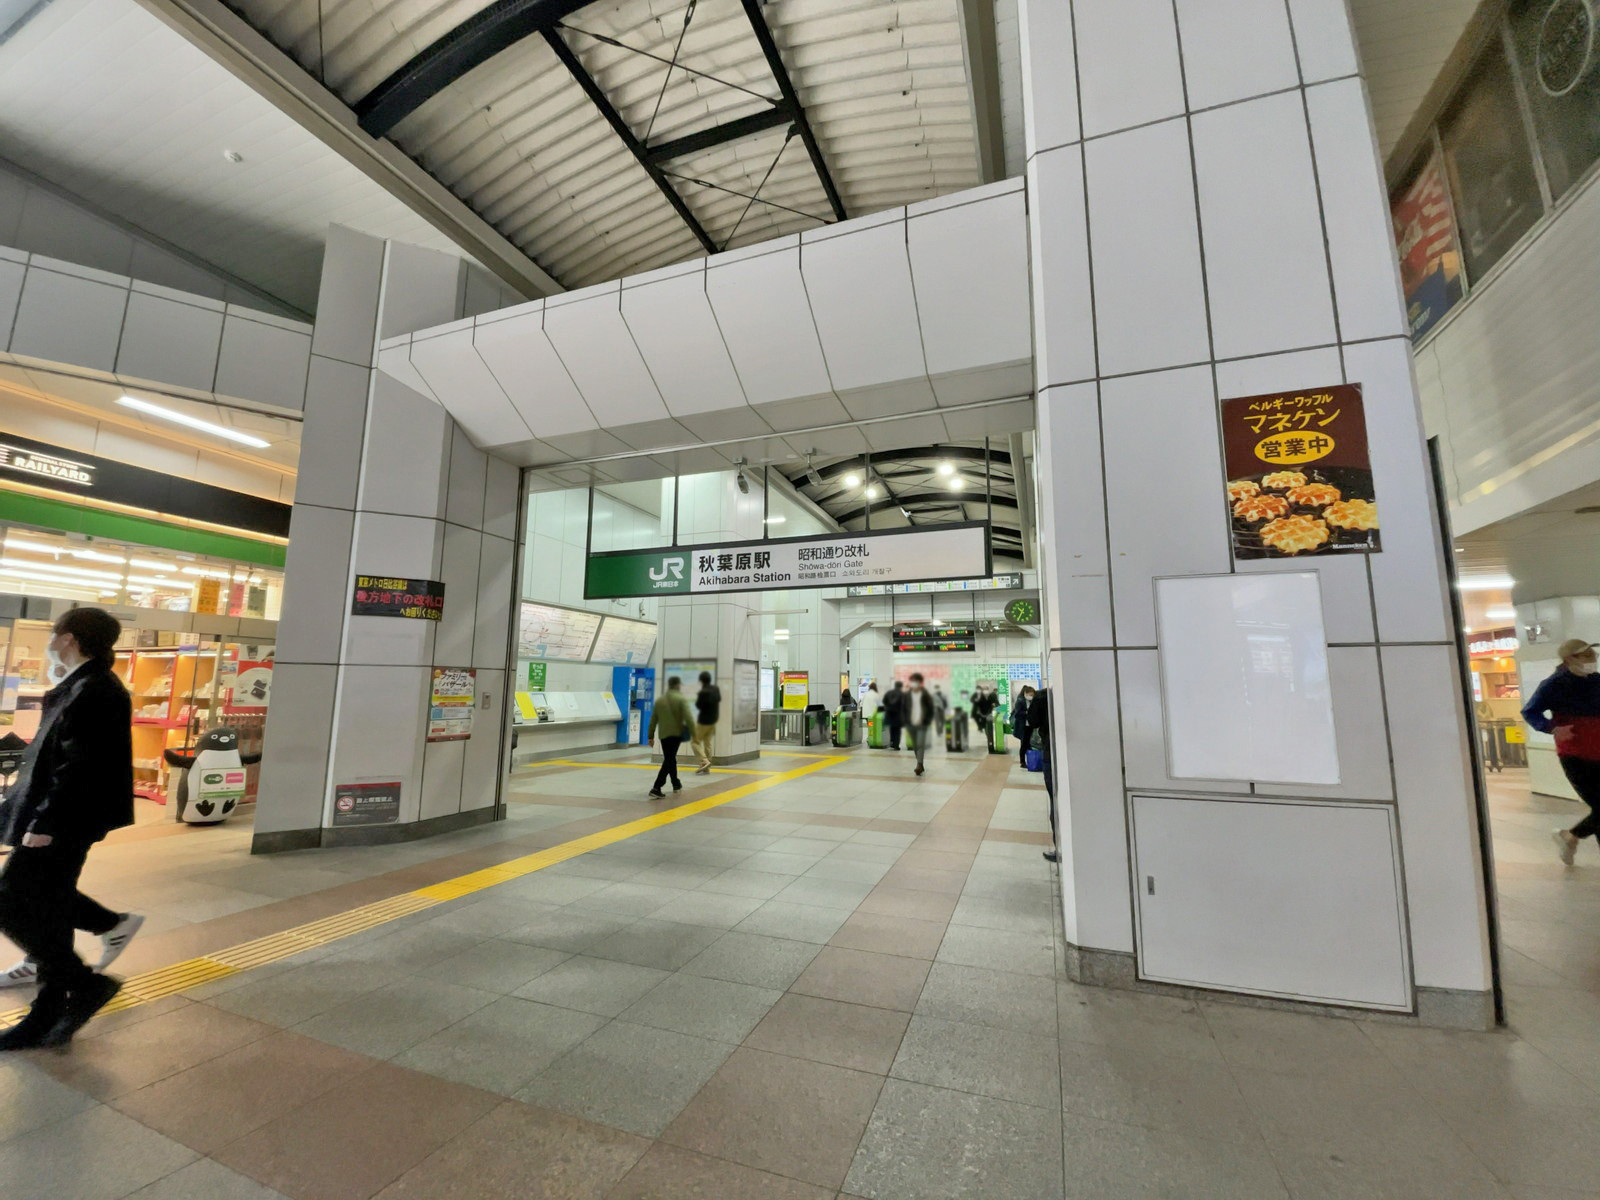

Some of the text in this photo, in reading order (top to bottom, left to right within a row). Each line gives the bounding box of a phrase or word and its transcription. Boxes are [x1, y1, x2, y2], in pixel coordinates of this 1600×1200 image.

[1249, 394, 1333, 411] ベルギーワッフル
[1243, 408, 1340, 434] マネケン
[1261, 435, 1328, 459] 営業中
[15, 456, 90, 482] RAILYARD
[699, 551, 771, 573] 秋葉原駅
[798, 543, 870, 561] 昭和通り改札
[649, 556, 684, 581] JR
[798, 560, 864, 571] Shōwa-dōri Gate
[699, 572, 791, 586] Akihabara Station
